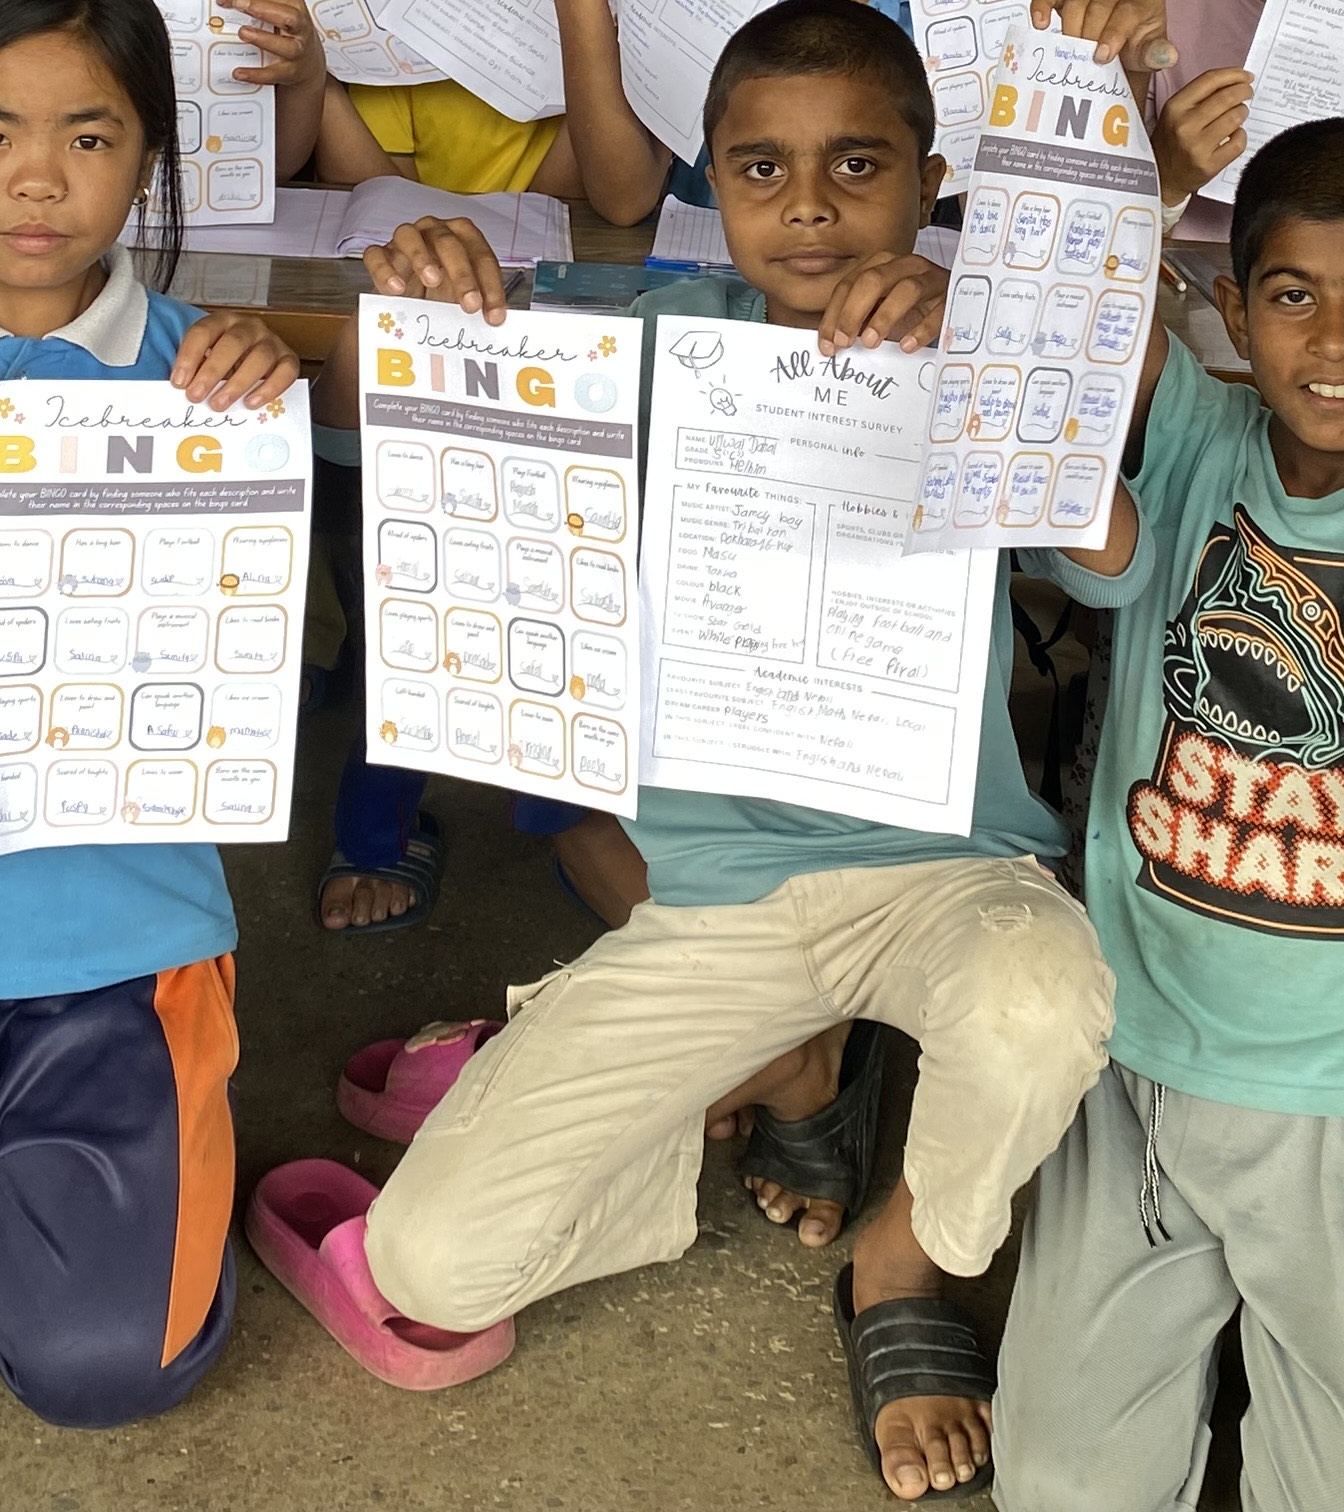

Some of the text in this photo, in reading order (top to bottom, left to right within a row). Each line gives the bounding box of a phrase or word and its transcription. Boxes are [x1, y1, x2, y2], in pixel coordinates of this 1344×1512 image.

[989, 83, 1148, 152] BING
[416, 314, 578, 362] Icebreaker
[377, 348, 618, 413] BINGO
[770, 350, 900, 401] All About
[814, 386, 849, 407] ME
[44, 395, 248, 428] Icebreaker
[756, 404, 904, 434] STUDENT INTEREST SURVEY
[790, 437, 866, 458] PERSONAL info
[19, 490, 37, 500] your
[39, 488, 67, 498] BINGO
[69, 490, 87, 499] card
[89, 490, 99, 501] by
[102, 488, 128, 502] finding
[183, 488, 196, 498] fits
[199, 488, 217, 496] each
[219, 487, 259, 498] description
[261, 487, 275, 496] and
[277, 486, 297, 495] write
[705, 482, 760, 499] favourite
[28, 499, 50, 509] their
[83, 499, 96, 508] the
[98, 499, 152, 511] corresponding
[154, 501, 179, 511] spaces
[193, 498, 206, 508] the
[209, 498, 227, 510] bingo
[229, 499, 248, 508] card
[842, 500, 888, 518] Hobbies
[754, 666, 809, 684] Academic
